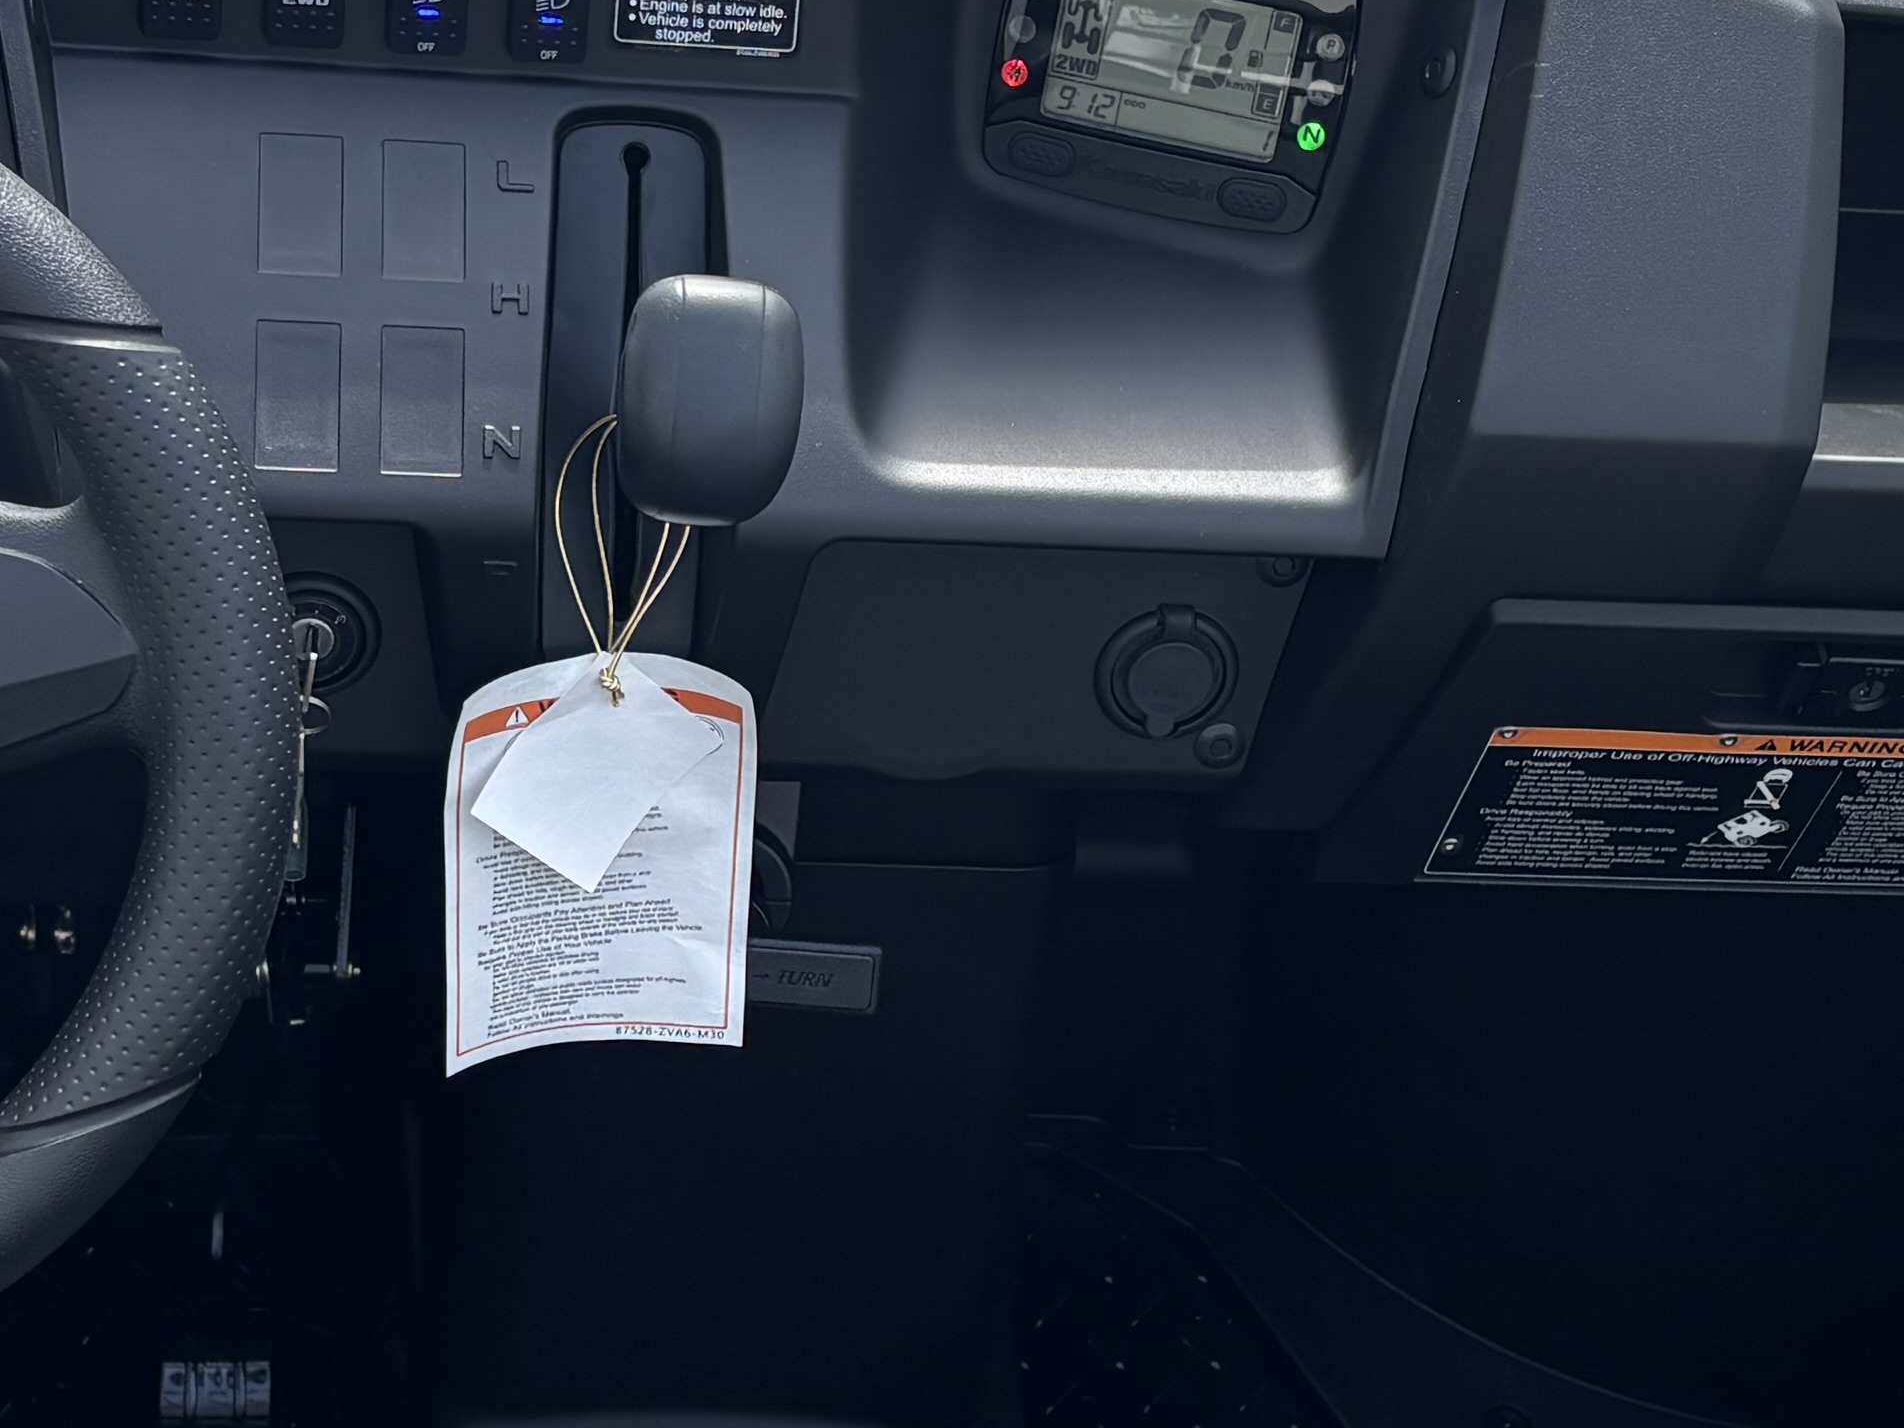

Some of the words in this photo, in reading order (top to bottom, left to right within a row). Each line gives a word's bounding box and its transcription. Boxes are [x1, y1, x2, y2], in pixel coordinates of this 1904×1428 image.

[692, 2, 704, 13] is
[707, 3, 721, 14] at
[724, 5, 757, 17] slow
[759, 5, 788, 19] idle.
[639, 11, 689, 27] Vehicle
[692, 16, 704, 28] is
[708, 17, 782, 36] completely
[1280, 17, 1292, 27] F
[655, 28, 715, 44] stopped.
[417, 42, 435, 52] OFF
[540, 50, 558, 60] OFF
[1056, 54, 1097, 75] 2WD
[1057, 85, 1115, 119] 9:12
[1262, 99, 1274, 109] E
[1303, 126, 1320, 143] N
[496, 160, 535, 192] L
[491, 283, 530, 314] H
[483, 425, 521, 459] N
[1533, 749, 1607, 760] Improper
[1611, 751, 1643, 761] Use
[1647, 753, 1663, 761] of
[1668, 753, 1768, 766] Off-Highway
[1773, 756, 1839, 767] Vehicles
[1843, 759, 1876, 768] Can
[777, 970, 834, 987] TURN
